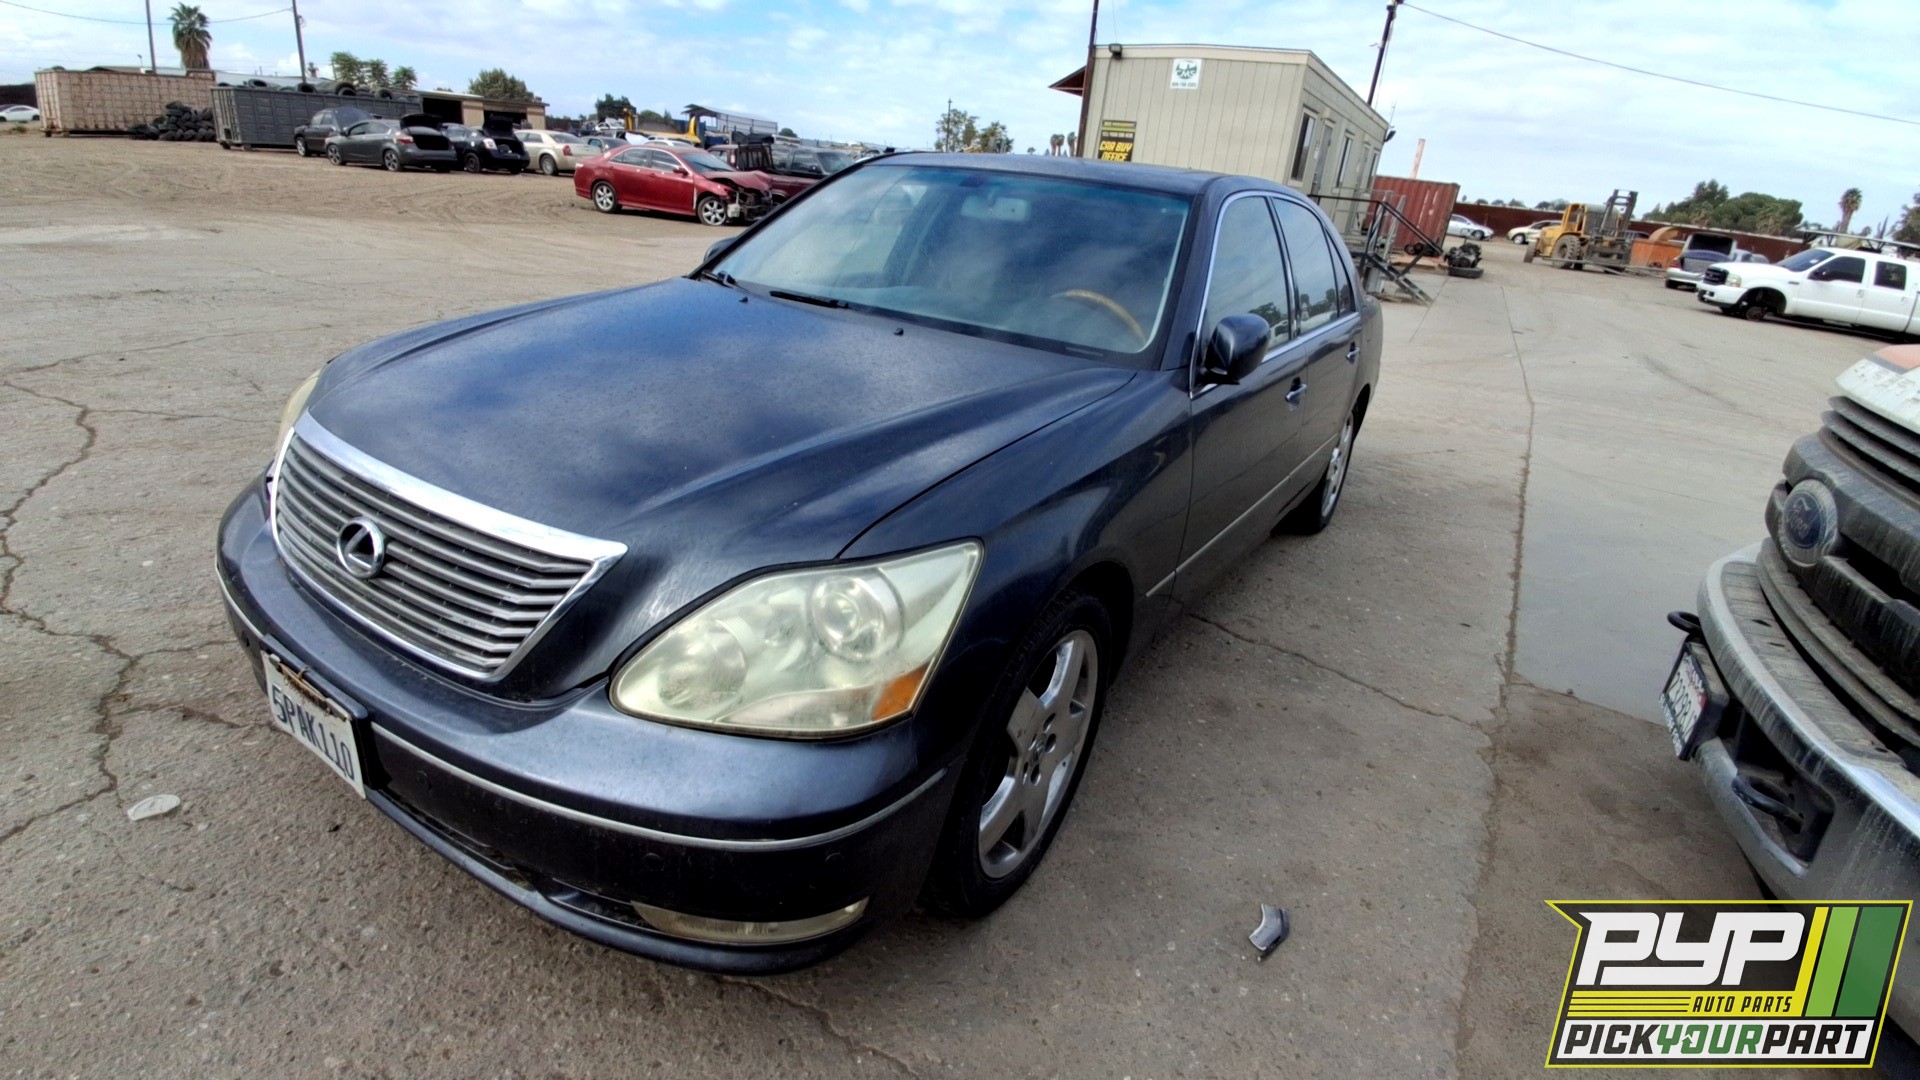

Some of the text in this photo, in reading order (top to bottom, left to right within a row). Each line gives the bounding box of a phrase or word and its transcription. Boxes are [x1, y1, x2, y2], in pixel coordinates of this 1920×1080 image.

[1099, 141, 1133, 152] CAR BUY
[1101, 151, 1128, 161] OFFICE
[272, 685, 355, 781] 5PAK110
